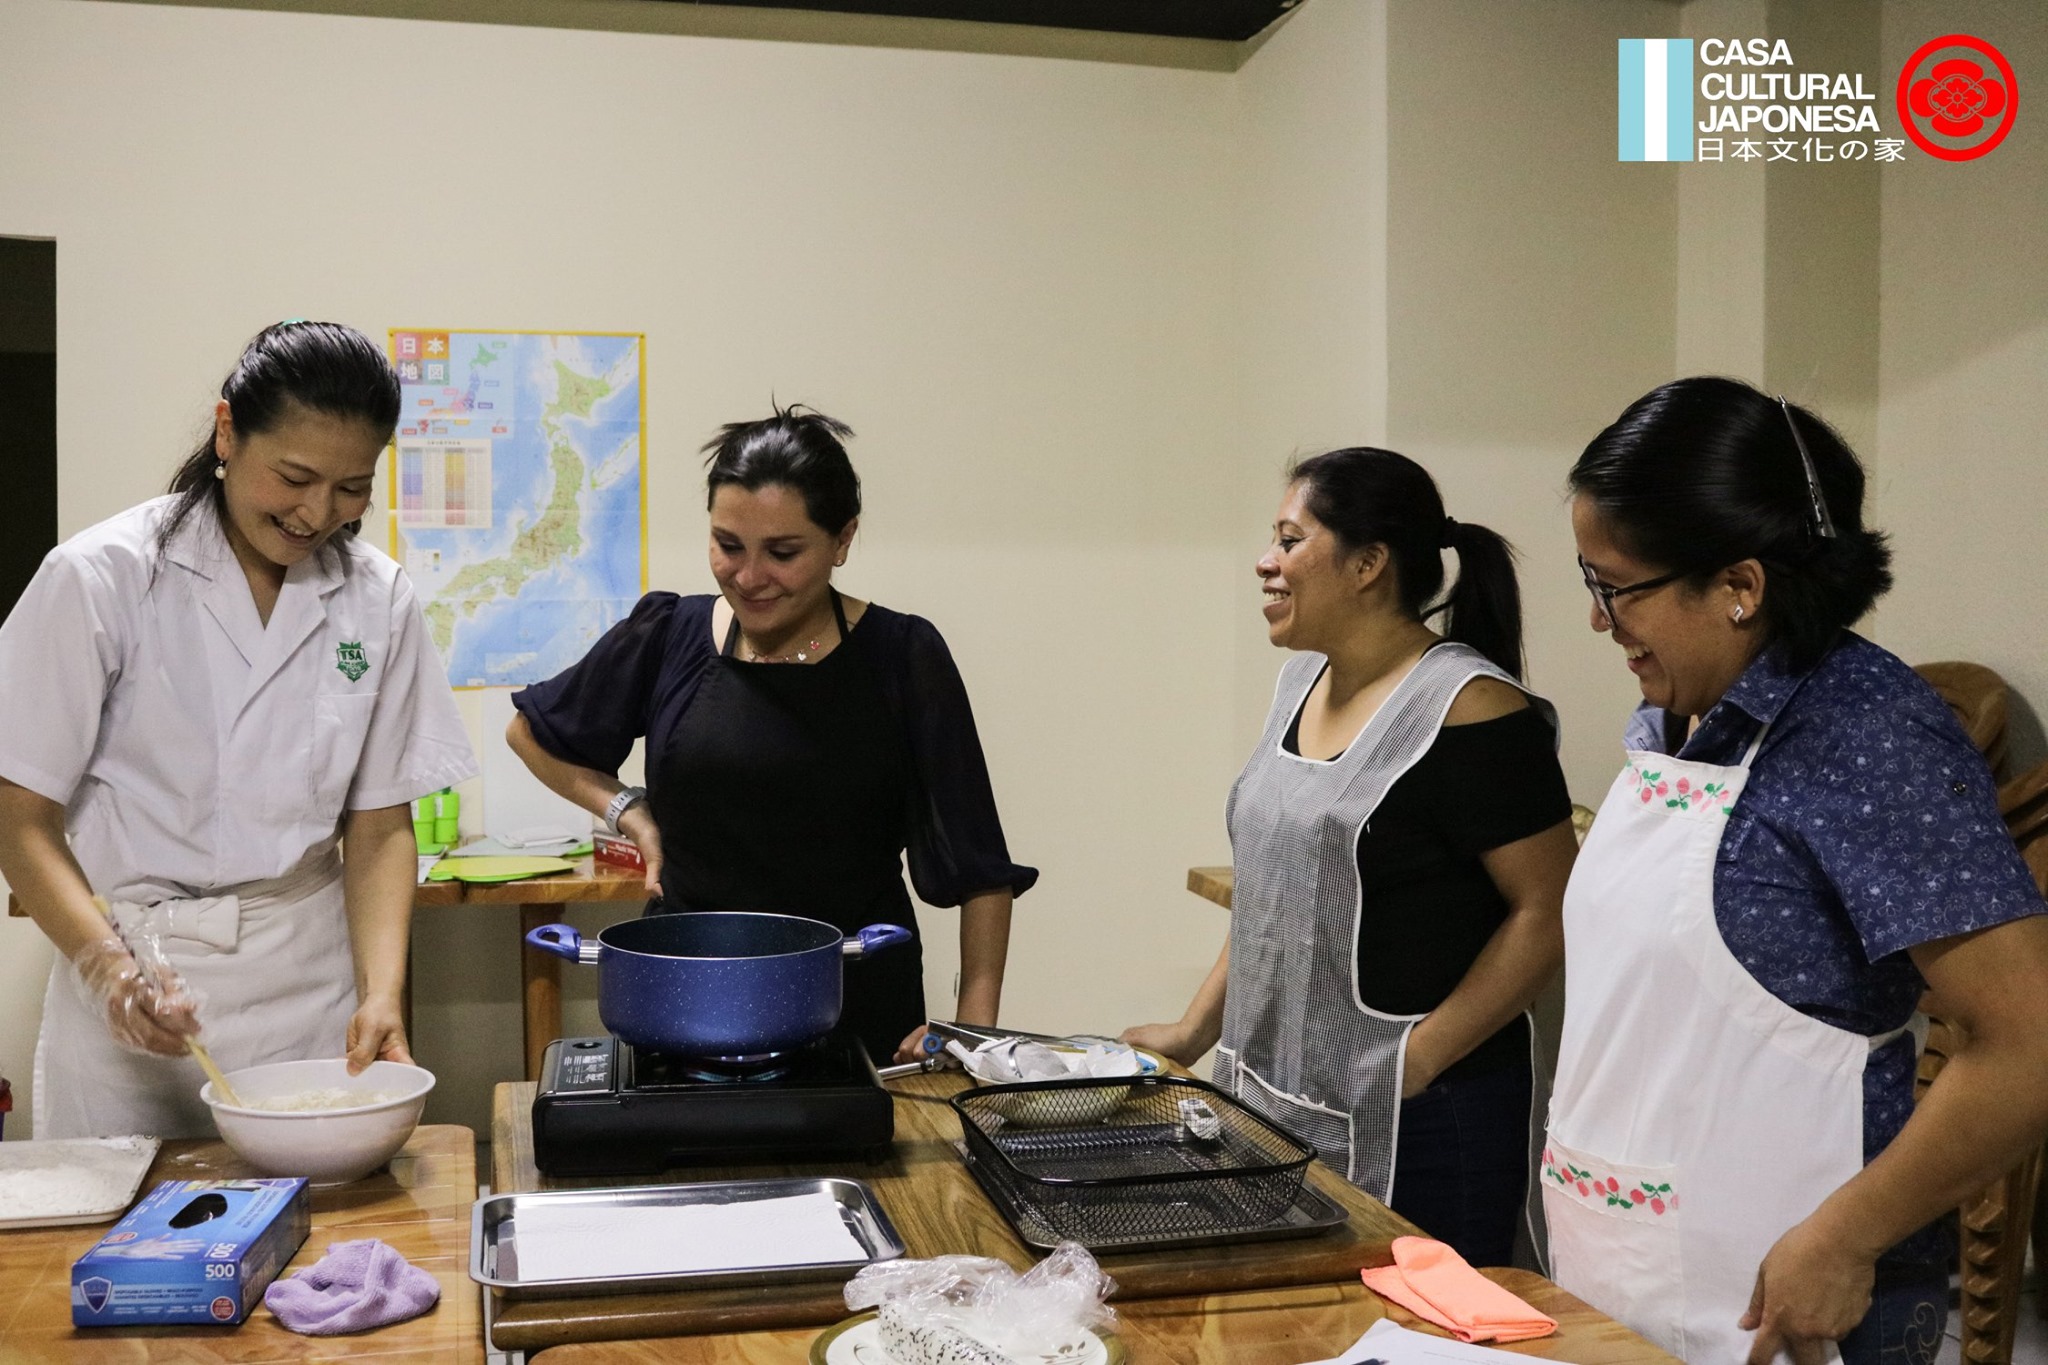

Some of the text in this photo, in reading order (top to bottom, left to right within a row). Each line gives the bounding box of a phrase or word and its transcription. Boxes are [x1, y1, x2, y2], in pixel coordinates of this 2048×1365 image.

[402, 337, 443, 354] 日本
[400, 362, 443, 380] 地図
[340, 649, 362, 660] TSA
[204, 1263, 235, 1278] 500
